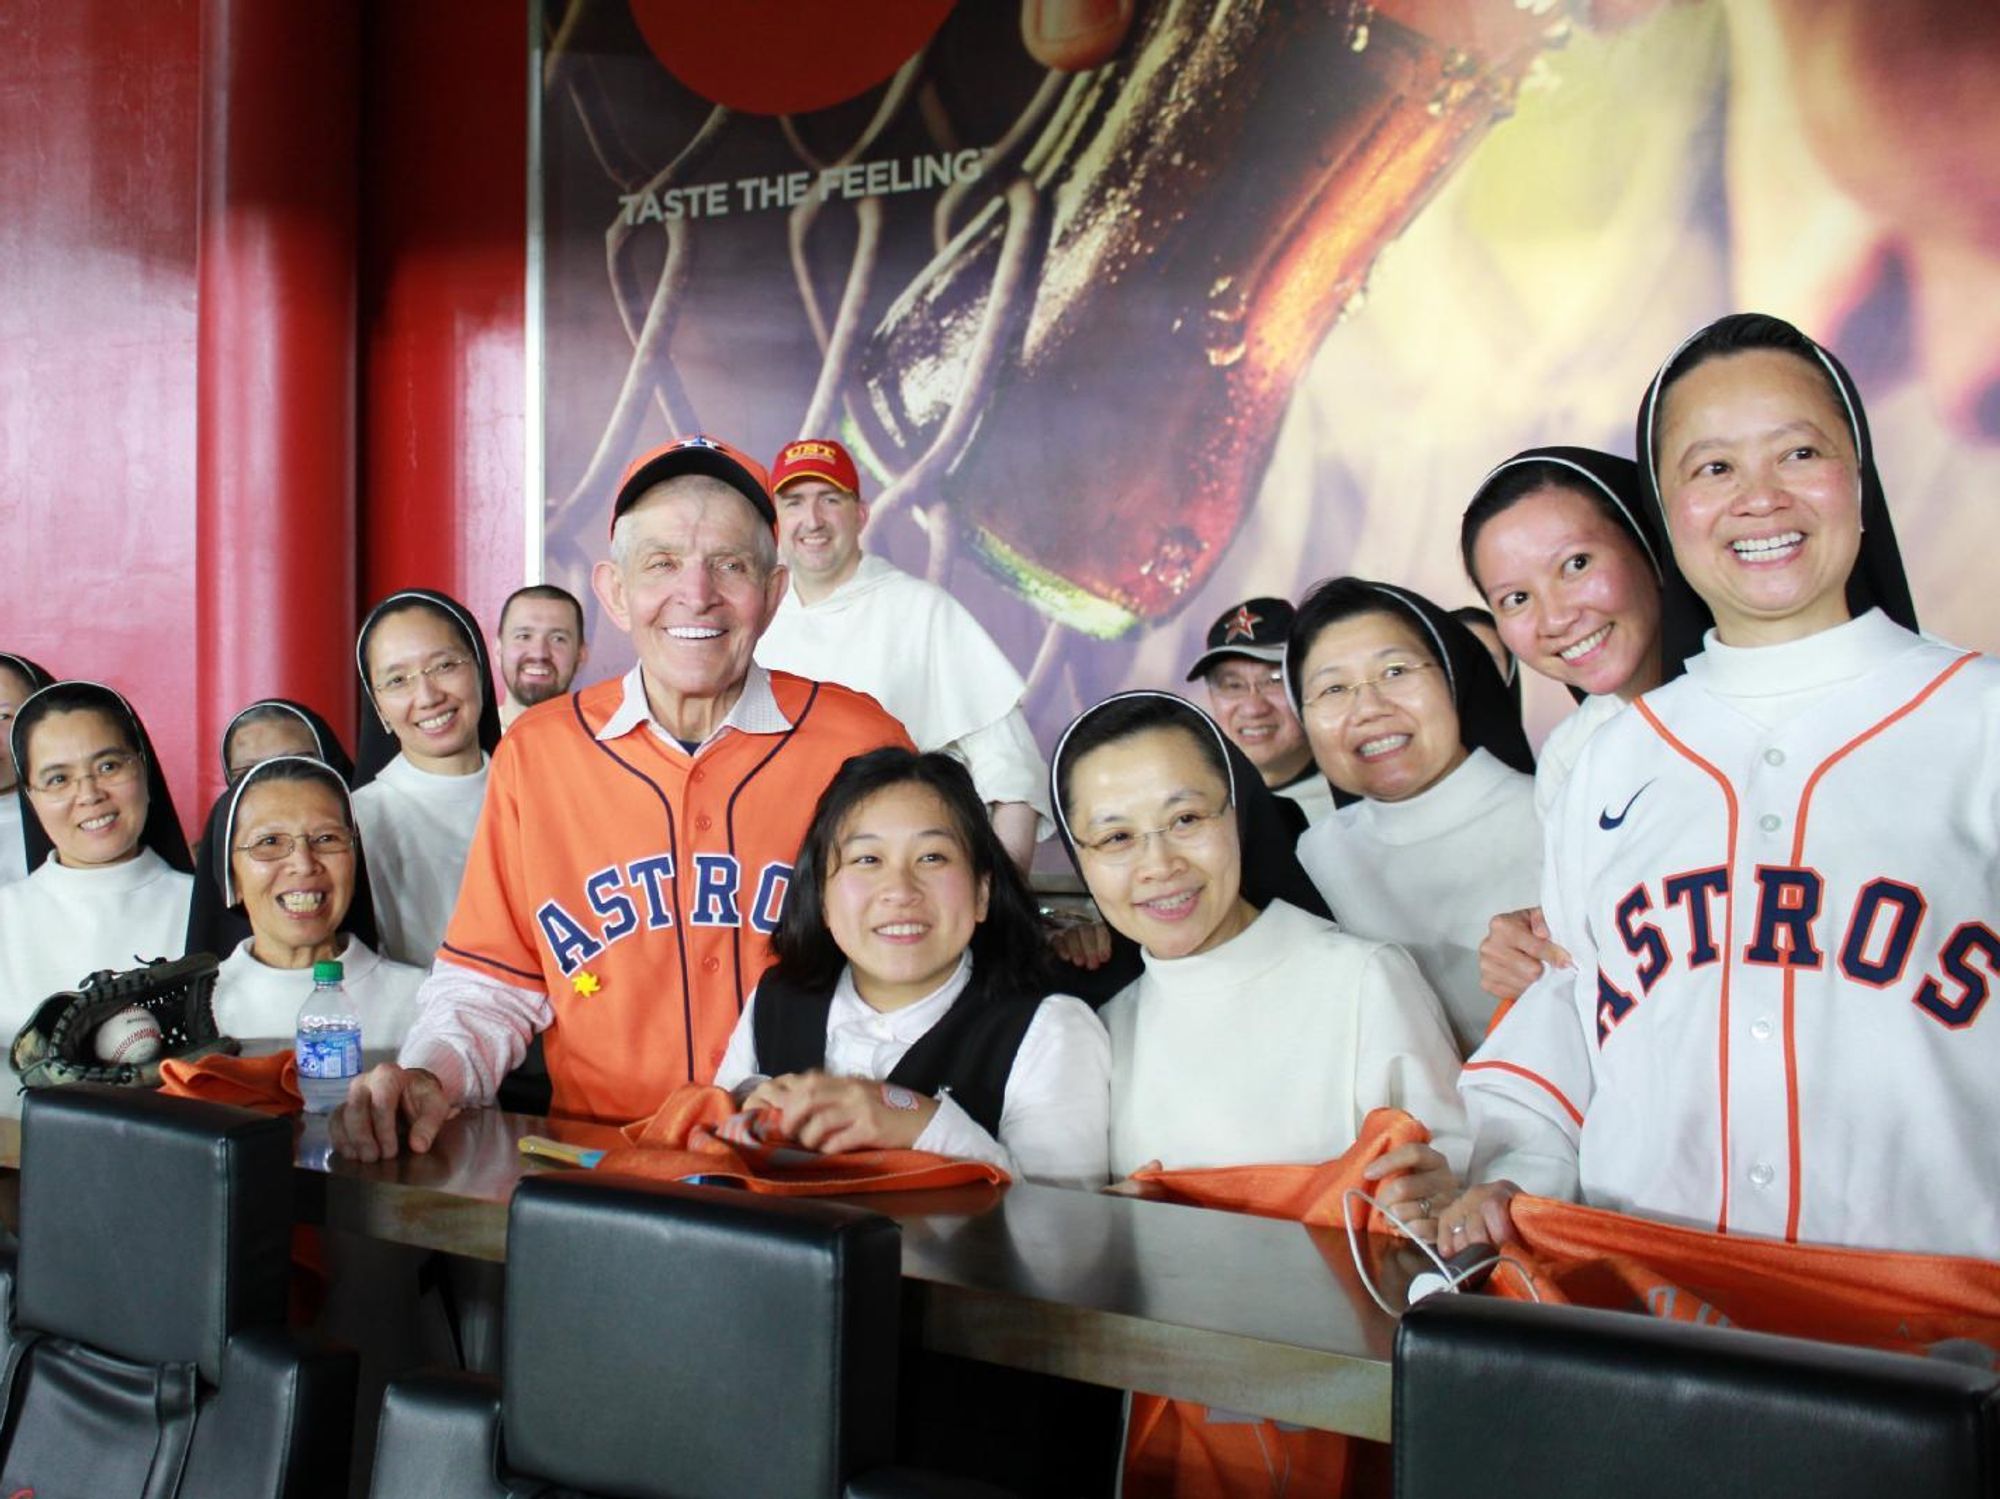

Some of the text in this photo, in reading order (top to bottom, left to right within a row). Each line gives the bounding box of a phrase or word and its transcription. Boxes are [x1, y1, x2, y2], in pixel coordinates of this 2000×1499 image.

[619, 148, 982, 226] TASTE THE FEELING
[536, 852, 796, 977] ASTRO
